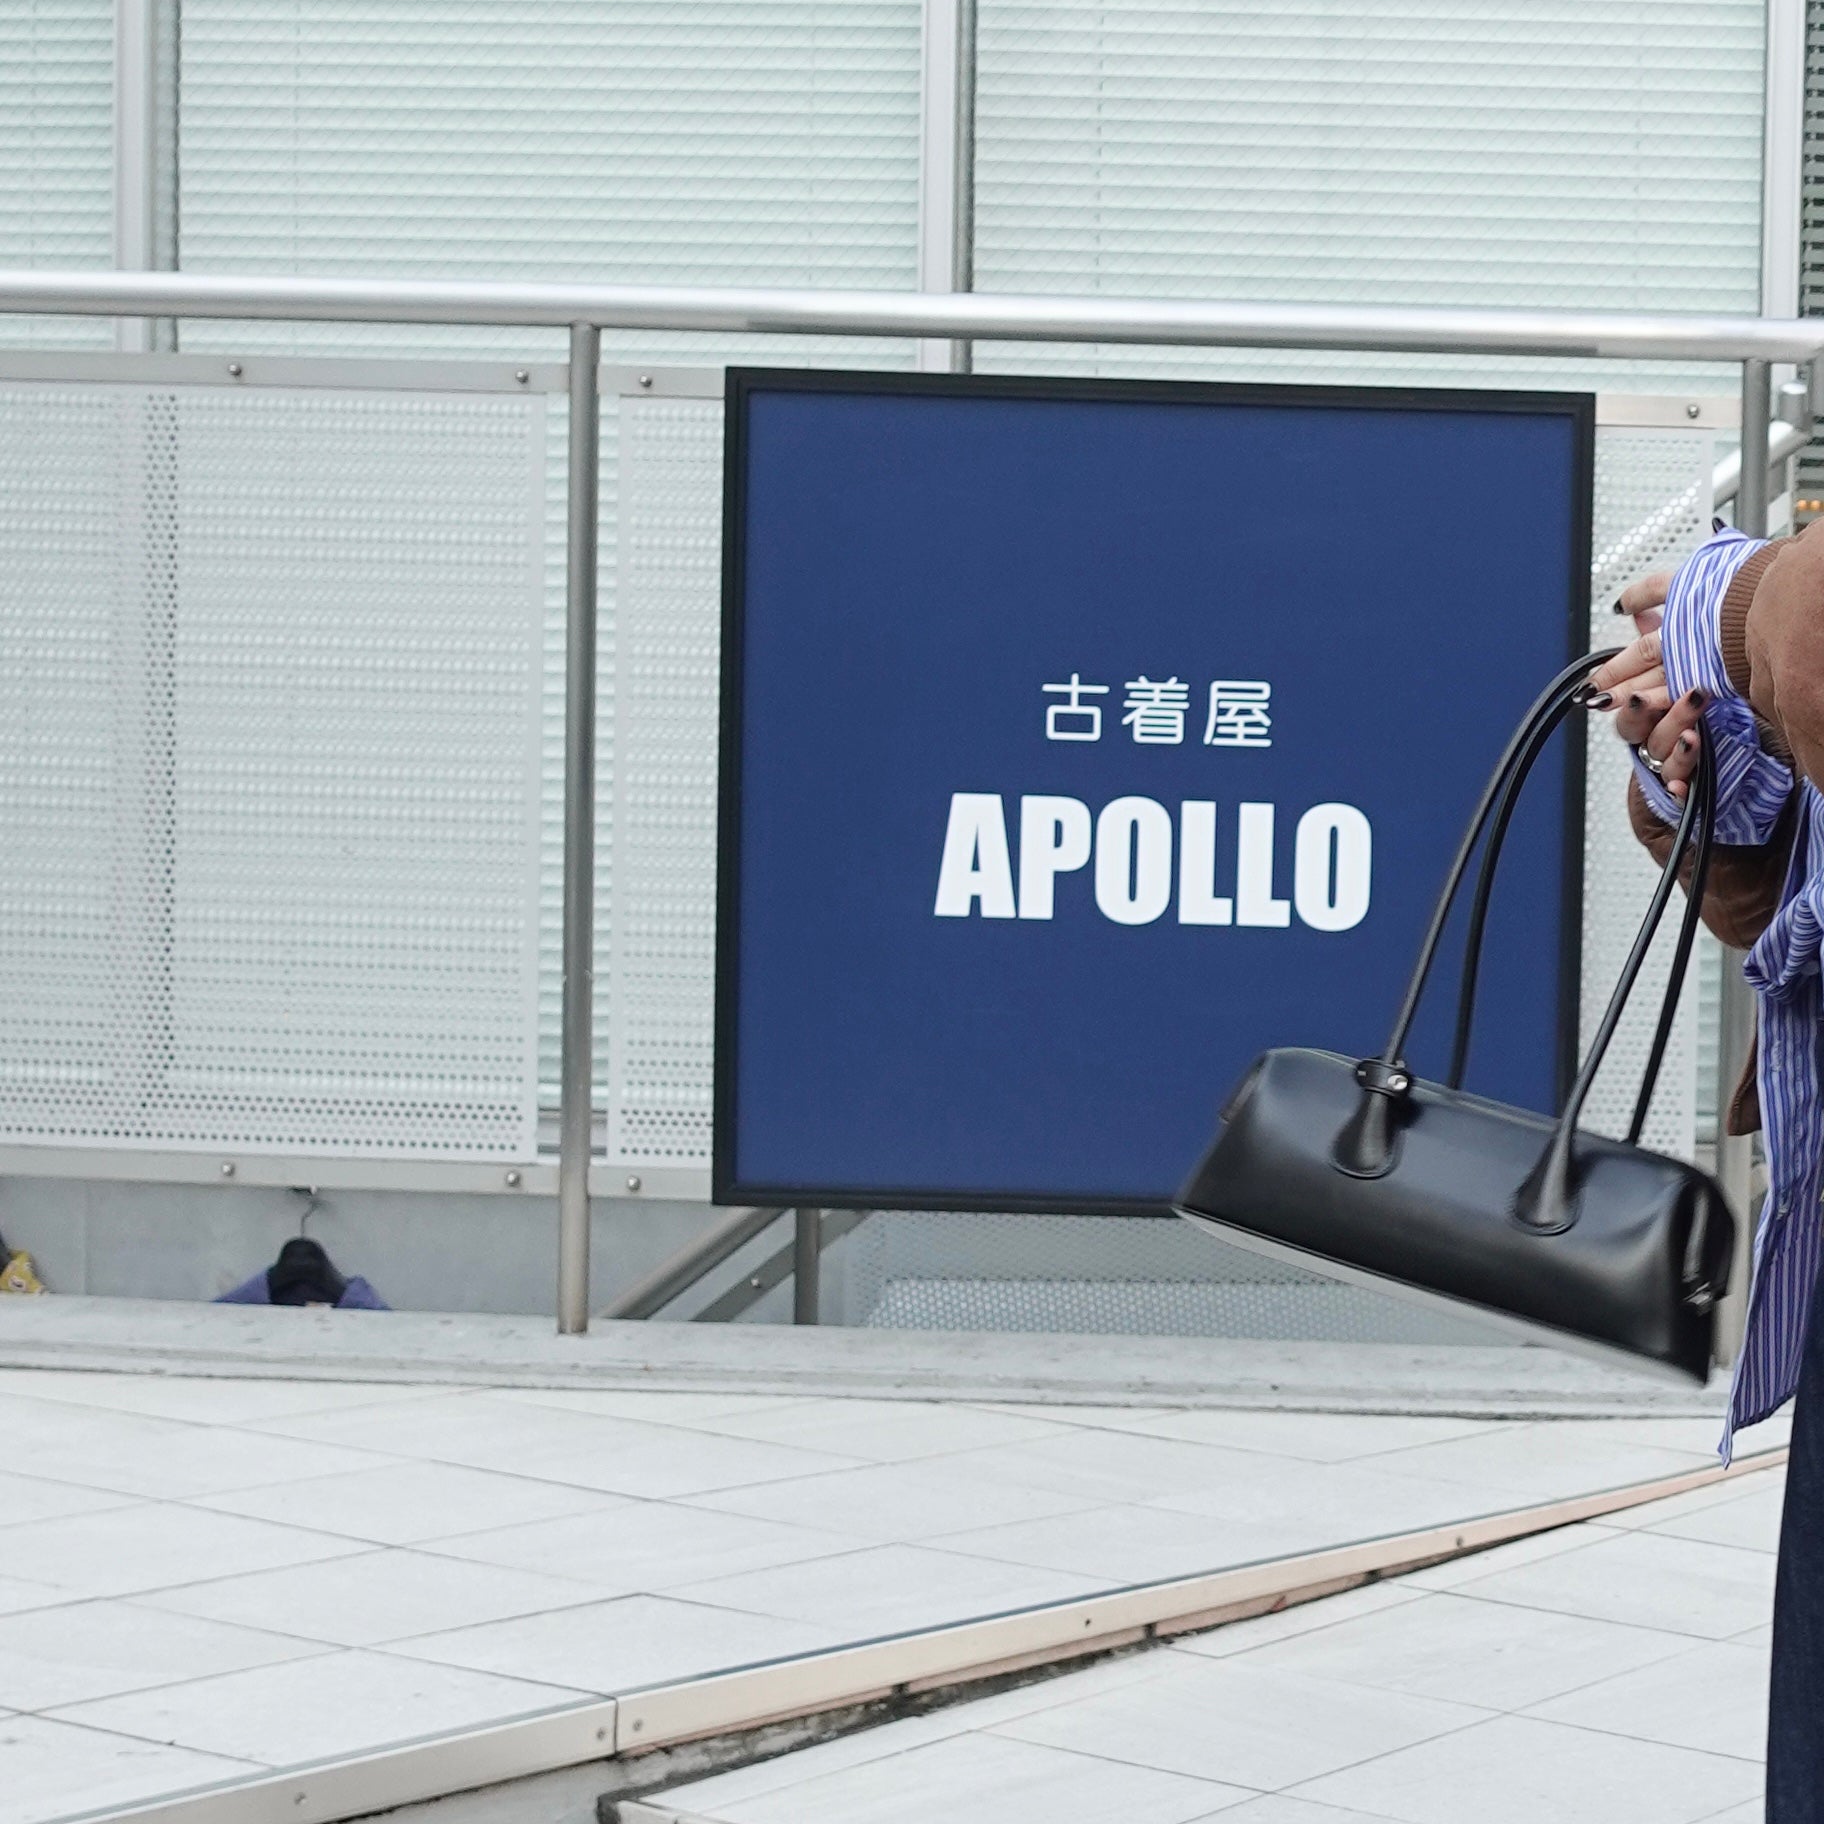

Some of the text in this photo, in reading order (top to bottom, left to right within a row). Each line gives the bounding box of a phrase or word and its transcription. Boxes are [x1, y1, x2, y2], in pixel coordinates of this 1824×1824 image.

[1042, 673, 1273, 748] 古着屋
[935, 793, 1372, 932] APOLLO
